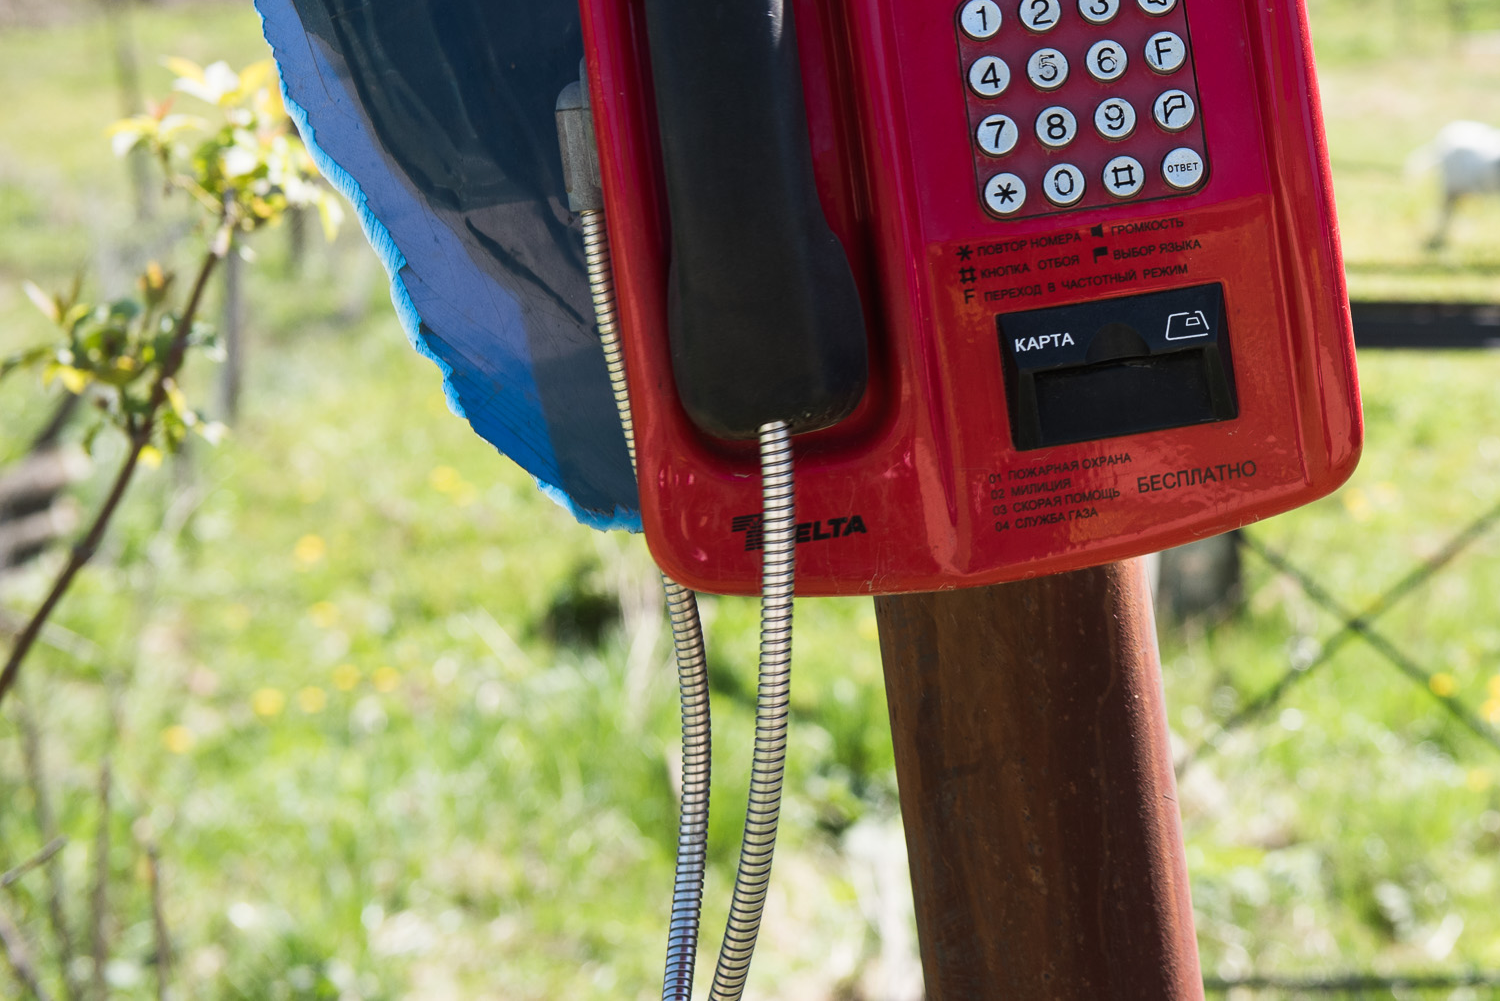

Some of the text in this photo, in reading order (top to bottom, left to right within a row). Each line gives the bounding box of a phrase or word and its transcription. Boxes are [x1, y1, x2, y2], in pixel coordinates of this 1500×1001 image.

[975, 4, 988, 32] 1
[1096, 46, 1118, 74] 6
[1153, 36, 1172, 65] F
[980, 61, 1001, 89] 4
[1037, 53, 1059, 82] 5
[1045, 112, 1067, 140] 8
[1103, 103, 1125, 131] 9
[984, 119, 1006, 149] 7
[1167, 161, 1199, 174] ОТВЕТ
[1053, 168, 1075, 196] 0
[1110, 217, 1184, 237] ГРОМКОСТЬ
[976, 232, 1082, 257] ПОВТОР НОМЕРА
[1113, 238, 1202, 261] ВЫБОР ЯЗЫКА
[980, 255, 1080, 279] КНОПКА ОТБОЯ
[963, 263, 1189, 305] F ПЕРЕХОД В ЧАСТОТНЫЙ РЕЖИМ
[1014, 331, 1075, 352] КАРТА
[988, 452, 1132, 485] 01 ПОЖАРНАЯ ОХРАНА
[1136, 460, 1257, 494] БЕСПЛАТНО
[991, 478, 1072, 500] 02 МИЛИЦИЯ
[992, 487, 1121, 516] 03 СКОРАЯ ПОМОЩЬ
[994, 506, 1098, 533] 04 СЛУЖБА ГАЗА
